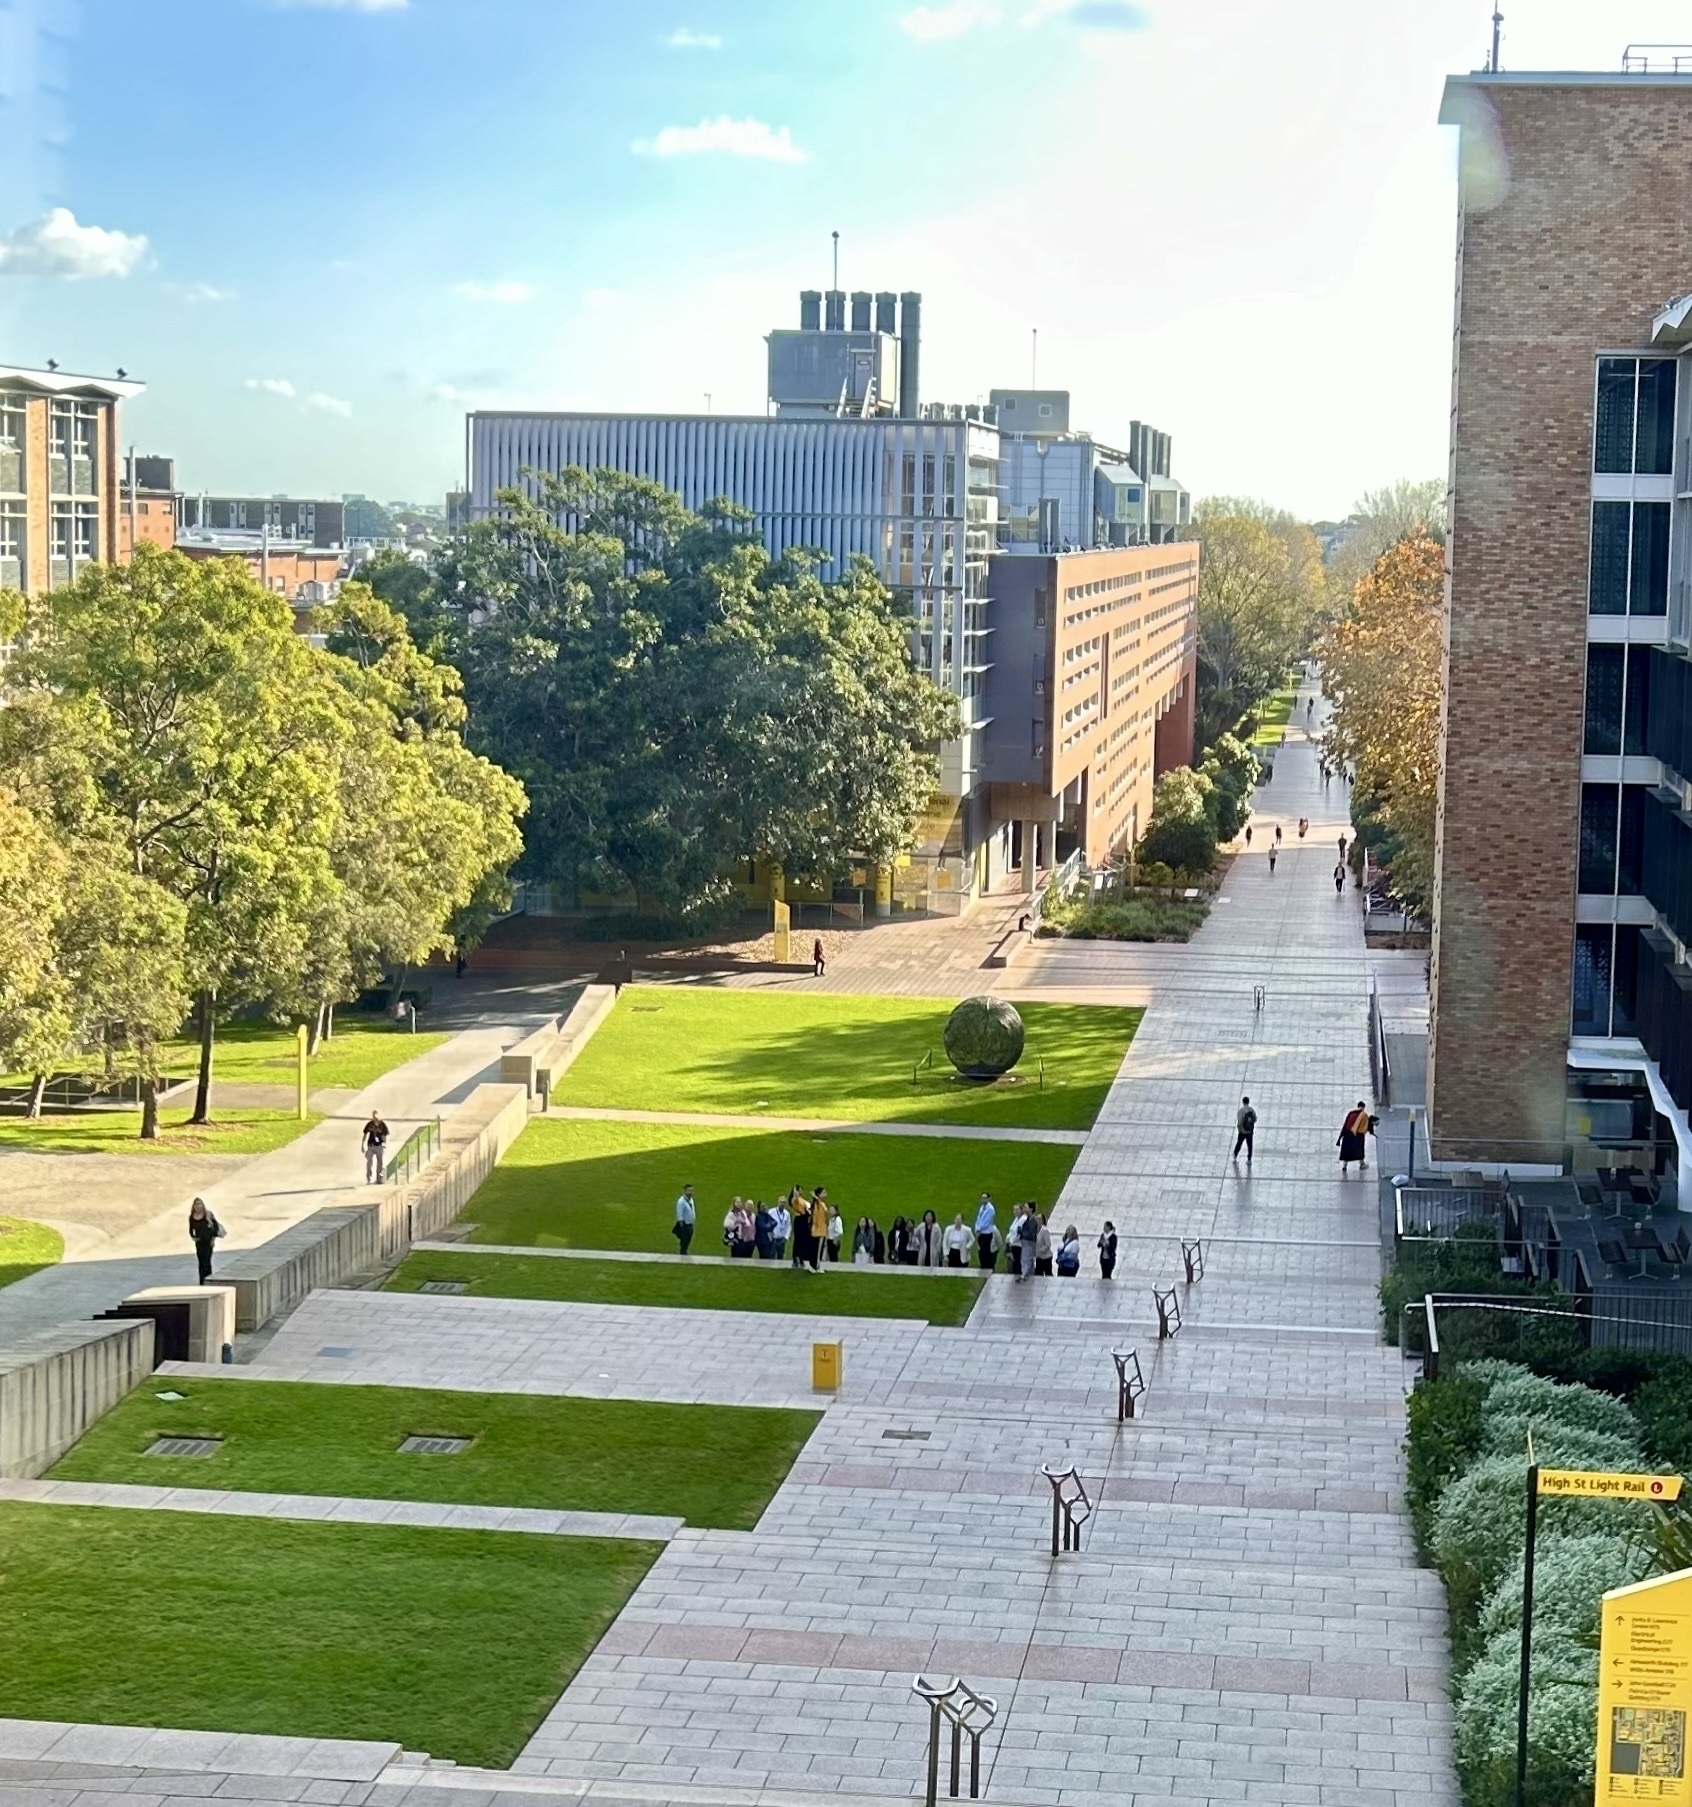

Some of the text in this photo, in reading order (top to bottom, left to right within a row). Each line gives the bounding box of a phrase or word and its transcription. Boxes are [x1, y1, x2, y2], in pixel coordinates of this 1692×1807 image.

[1543, 1477, 1570, 1490] High
[1575, 1478, 1586, 1489] St
[1590, 1479, 1620, 1492] Light
[1623, 1481, 1645, 1492] Rail
